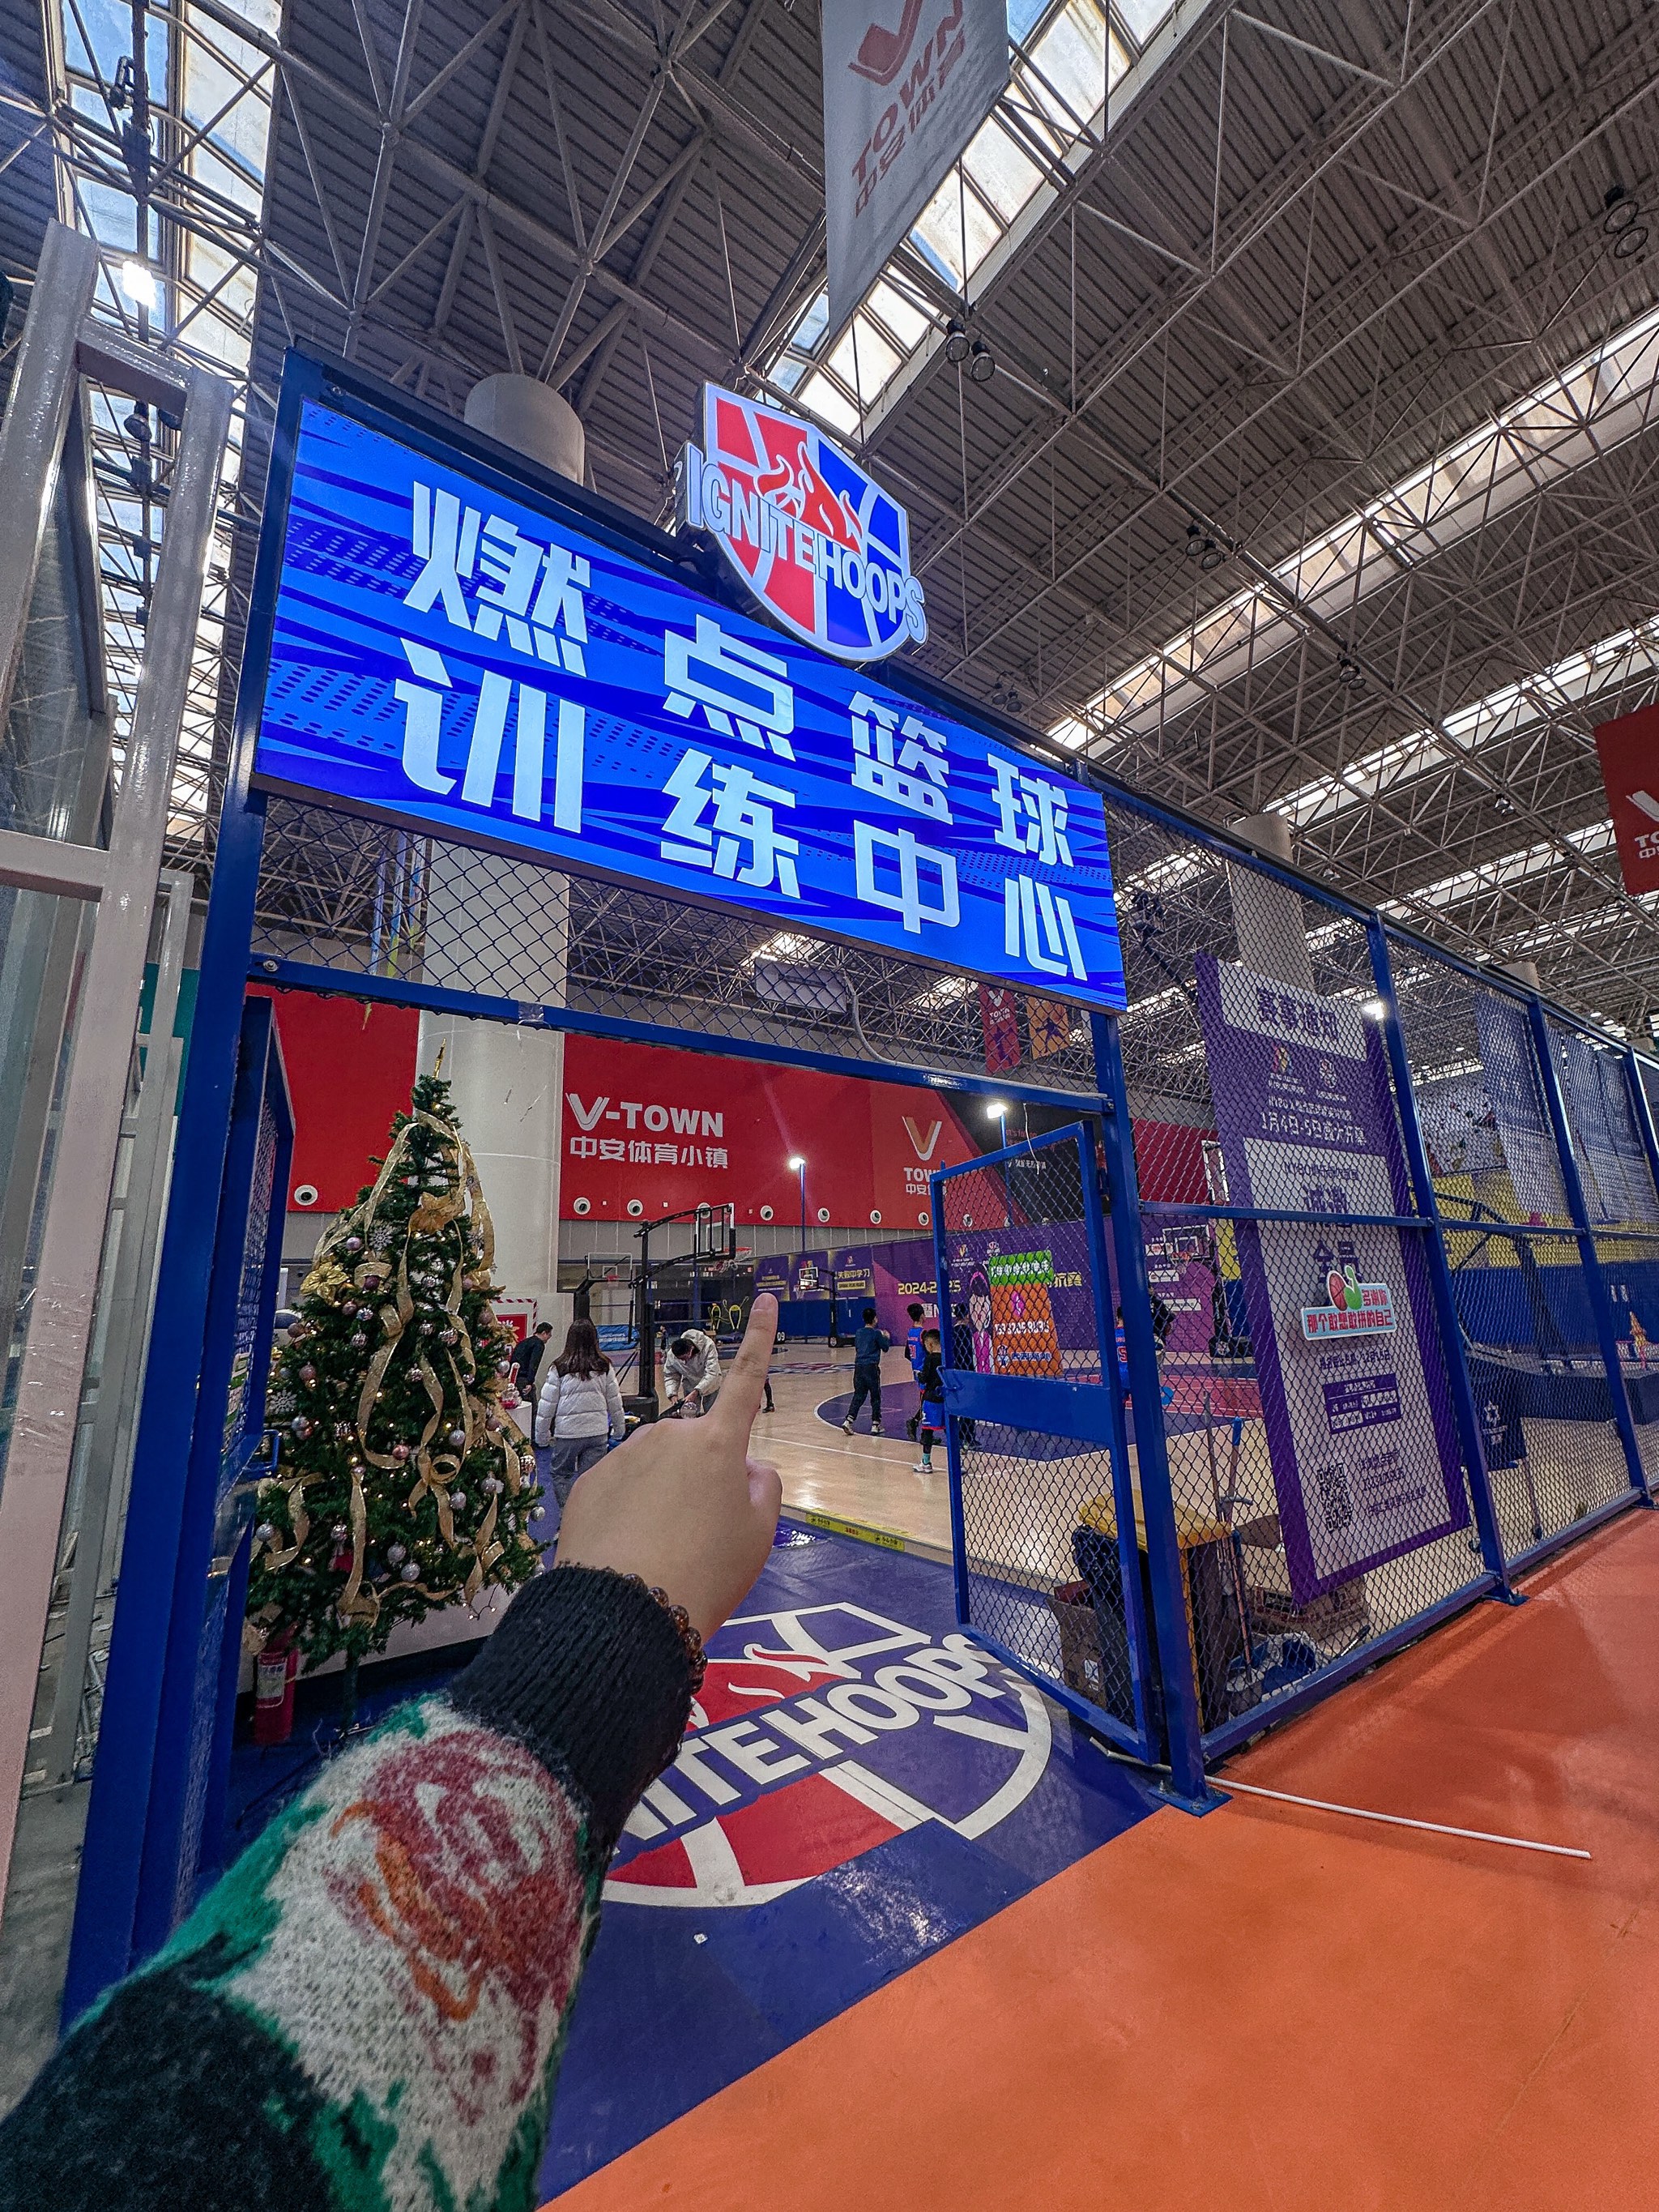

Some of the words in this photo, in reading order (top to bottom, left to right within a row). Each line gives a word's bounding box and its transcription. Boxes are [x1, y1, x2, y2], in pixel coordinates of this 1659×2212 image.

[688, 442, 928, 643] IGNITEHOOPS
[403, 480, 1074, 868] 燃点篮球
[394, 638, 1087, 981] 训练中心
[565, 1092, 724, 1138] V-TOWN
[569, 1136, 728, 1168] 中安体育小镇
[1307, 1309, 1393, 1334] 那个敢想敢拼的自己
